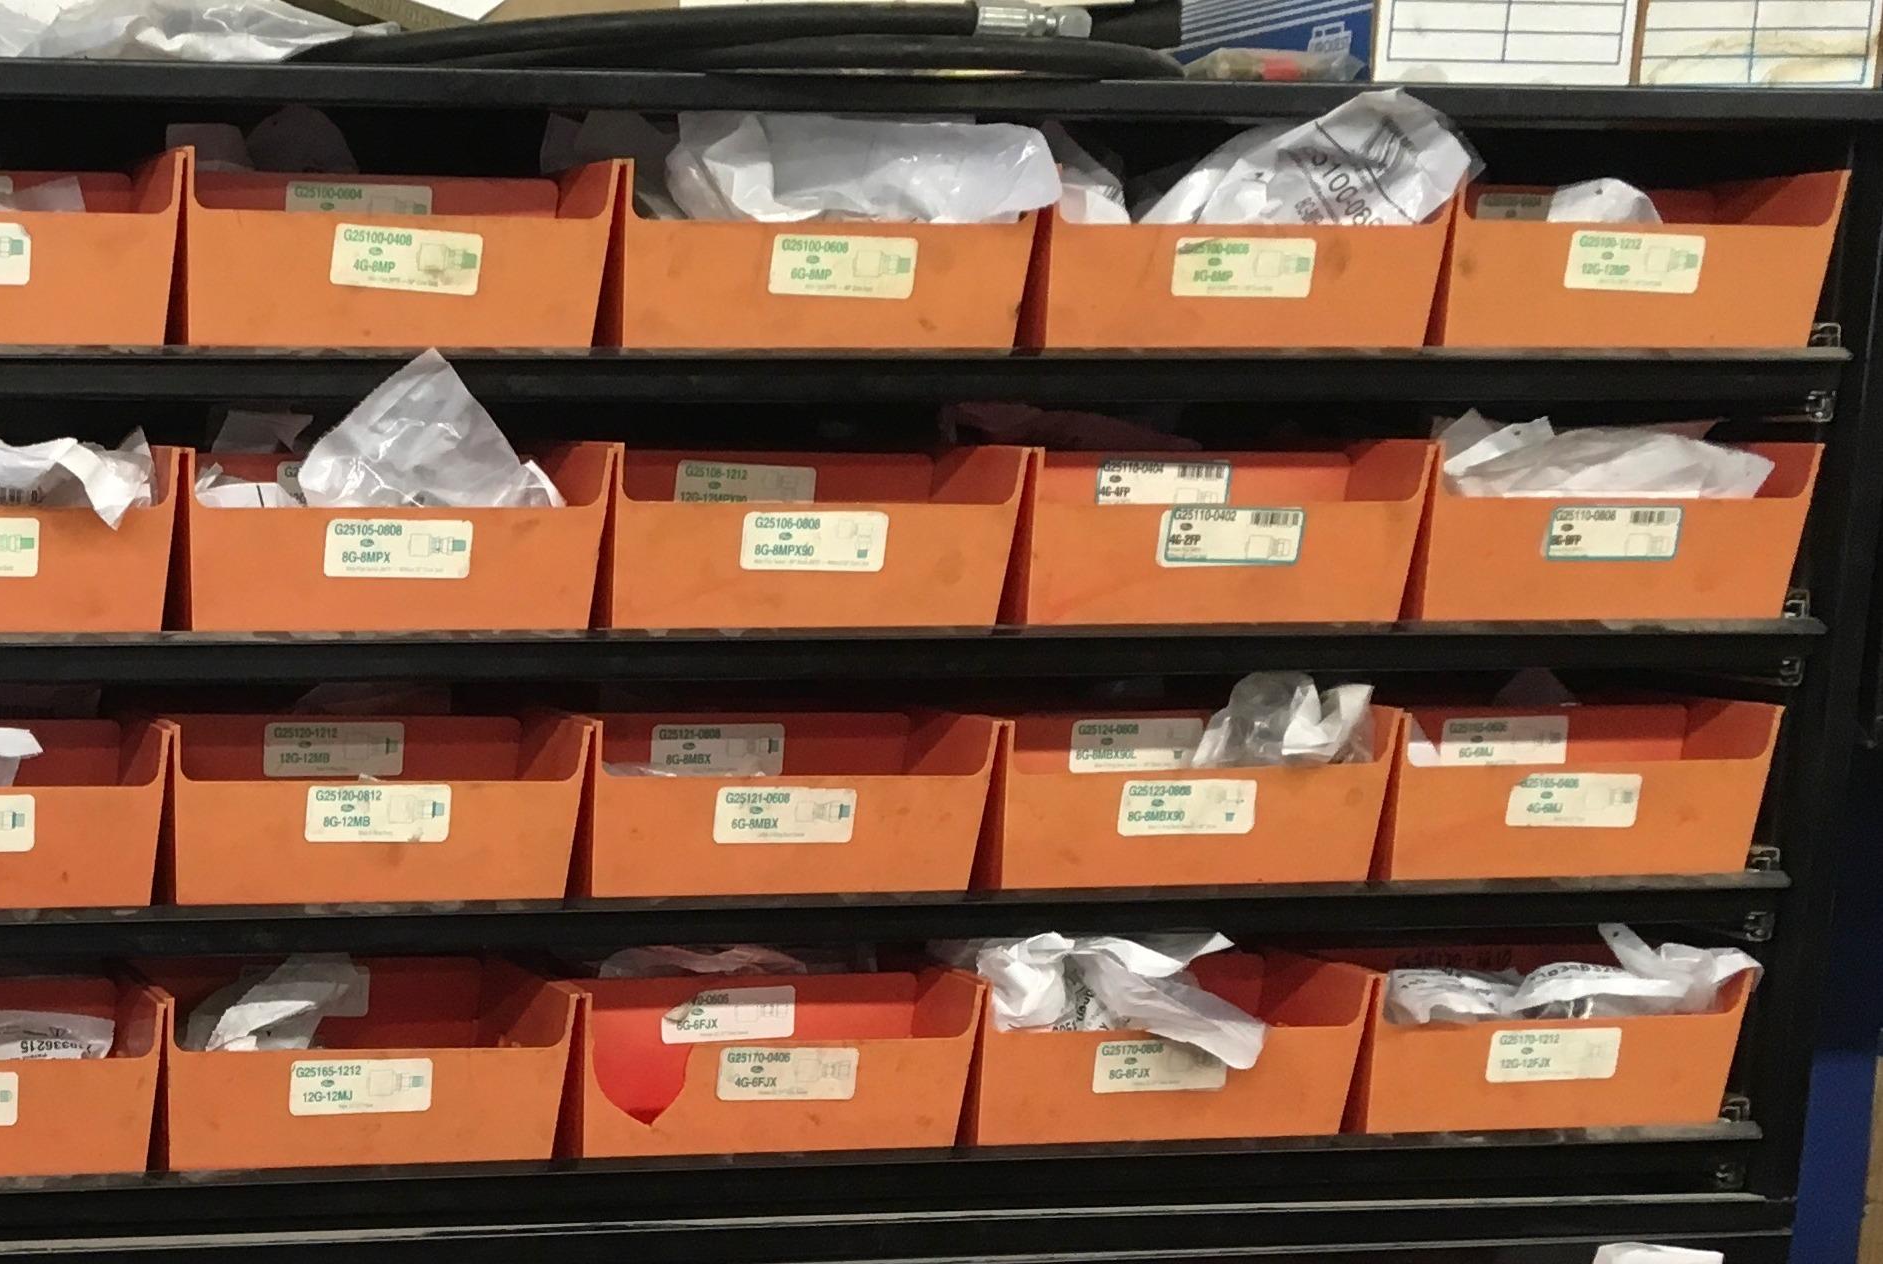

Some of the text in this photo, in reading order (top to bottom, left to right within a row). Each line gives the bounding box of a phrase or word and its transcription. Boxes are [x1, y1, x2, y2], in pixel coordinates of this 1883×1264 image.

[1175, 509, 1237, 523] G25110-0402
[334, 523, 402, 537] G25105-0808
[755, 516, 821, 531] G25106-0808
[1170, 534, 1200, 547] 4G-2FP
[754, 544, 814, 557] 8G-8MPX90
[342, 551, 390, 565] 8G-8MPX
[274, 726, 337, 740] G25120-1212
[666, 753, 712, 766] 8G-8MBX
[316, 789, 382, 803] G25120-0812
[726, 792, 790, 805] G25121-0608
[322, 814, 370, 829] 8G-12MB
[732, 817, 779, 830] 6G-8MBX
[727, 1051, 790, 1065] G25170-0406
[296, 1065, 361, 1080] G25165-1212
[1108, 1067, 1150, 1080] 8G-8FJX
[735, 1076, 777, 1088] 4G-6FJX
[302, 1090, 352, 1104] 12G-12MJ
